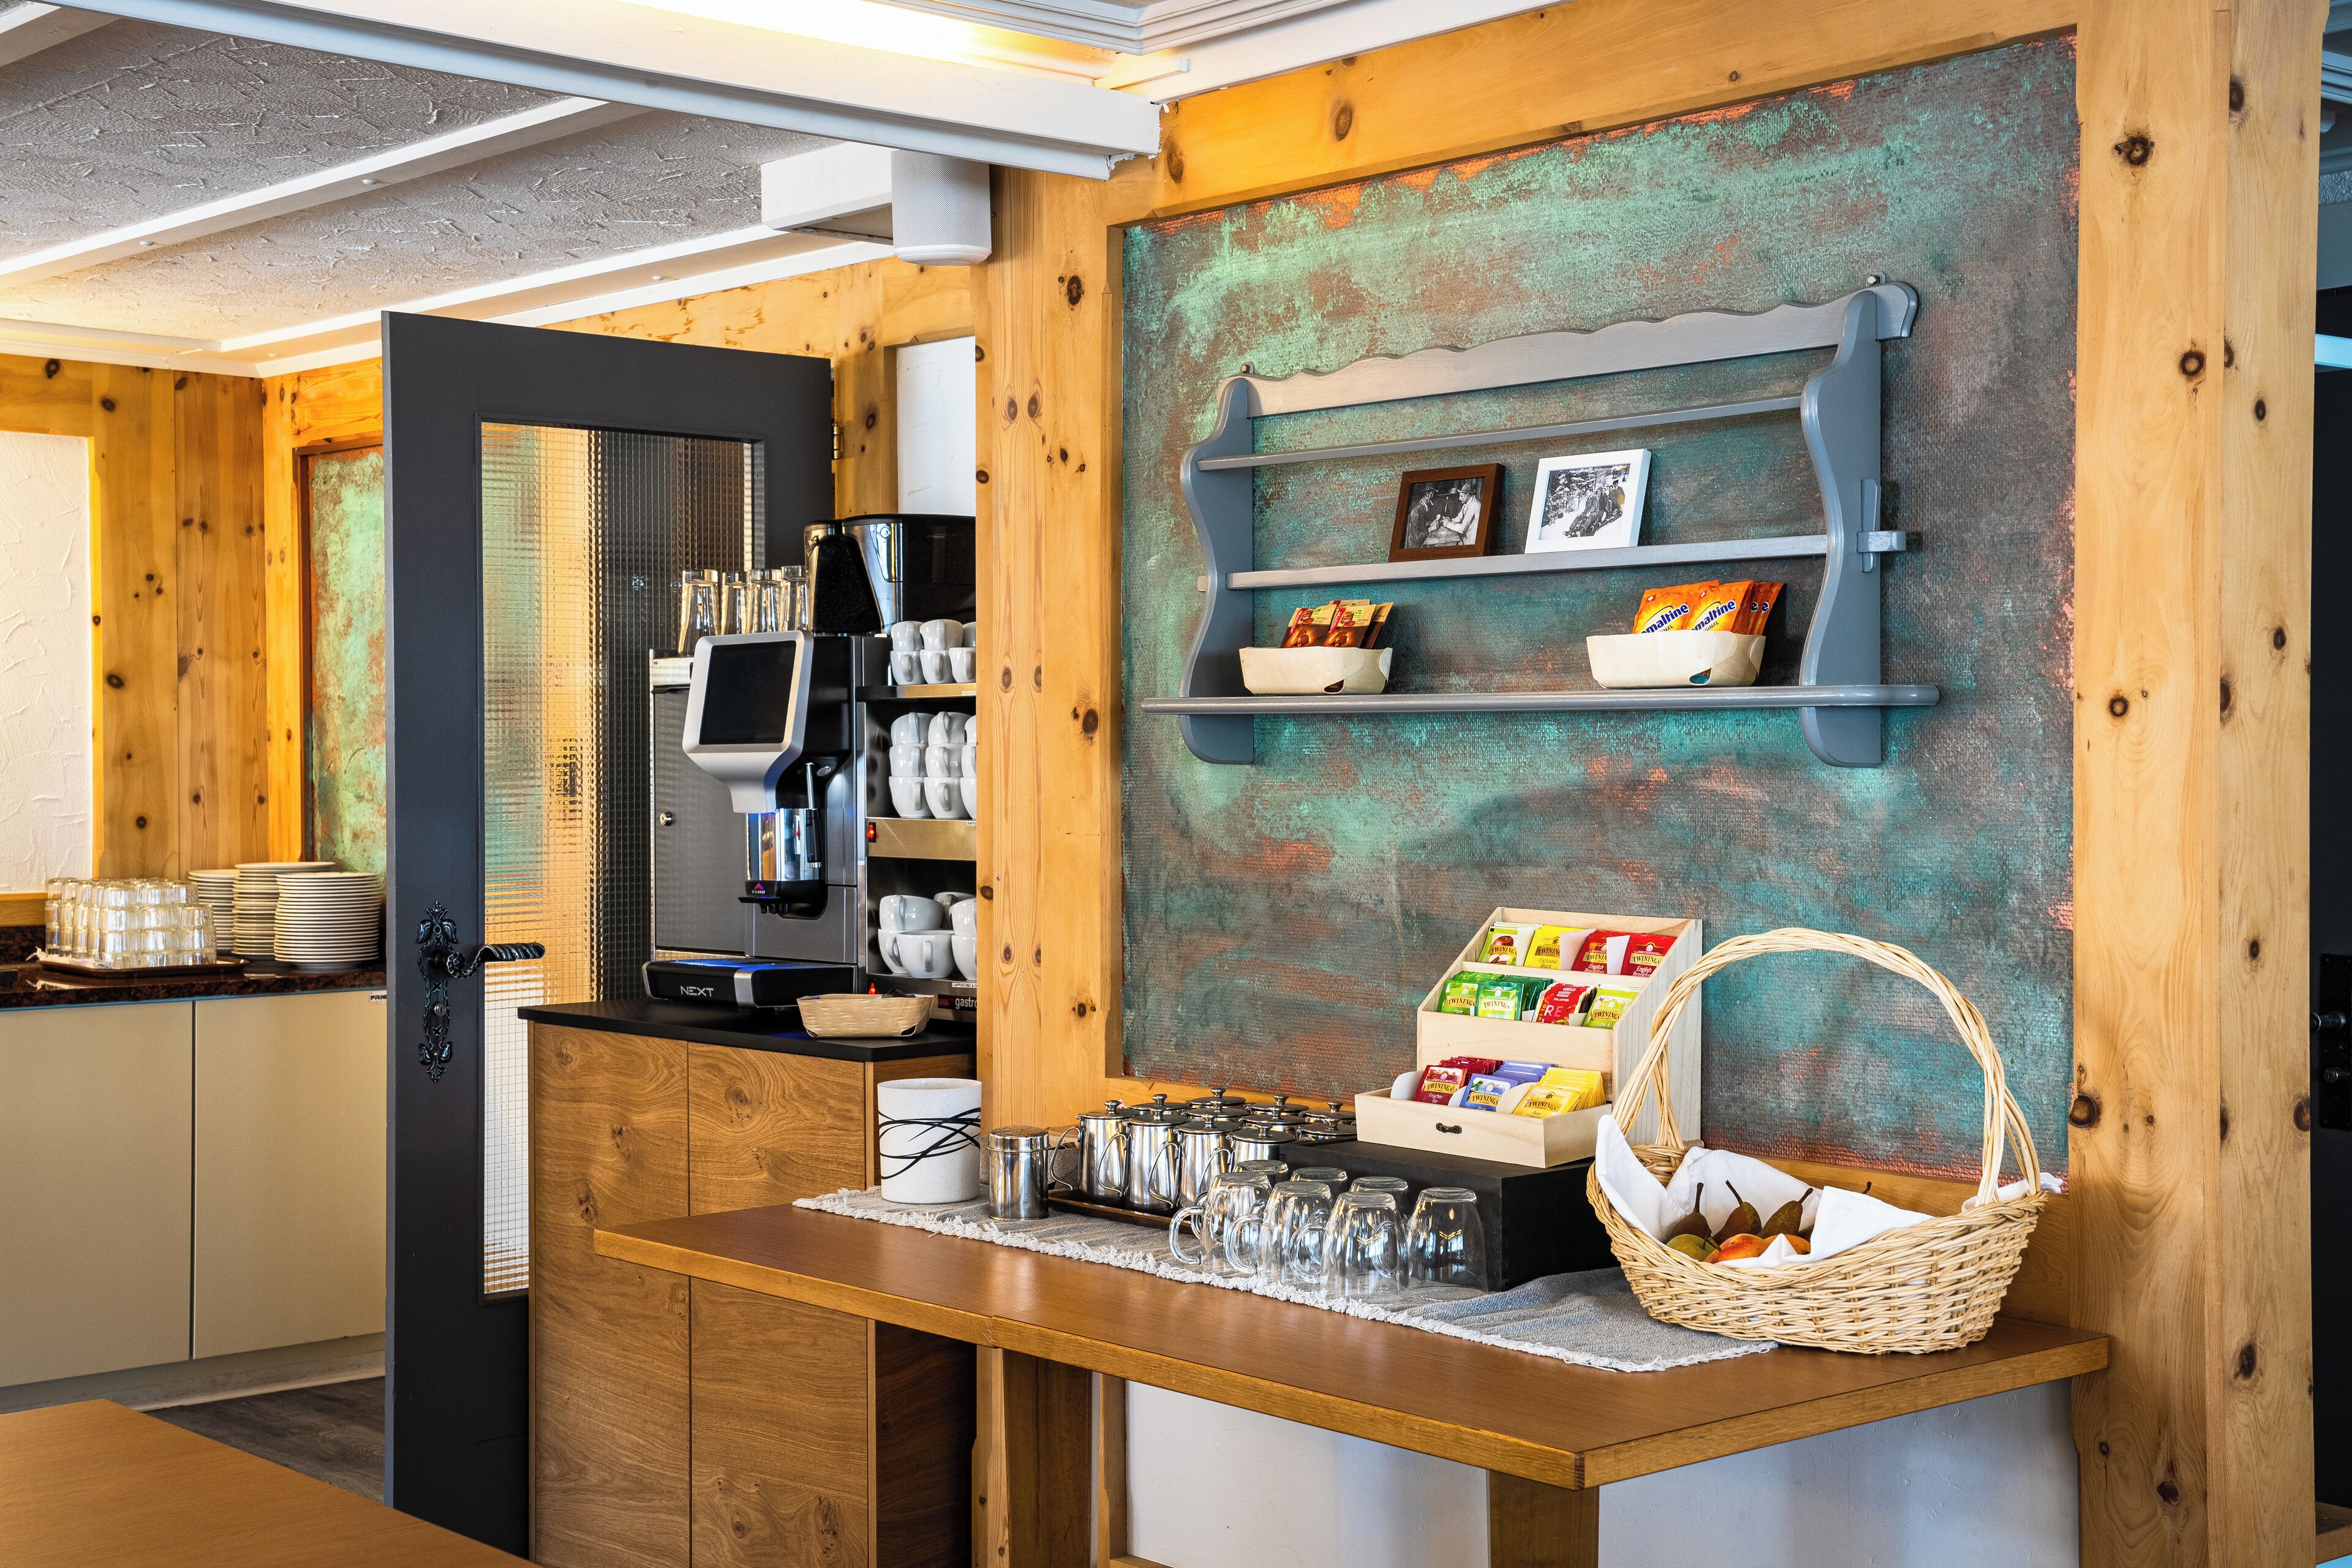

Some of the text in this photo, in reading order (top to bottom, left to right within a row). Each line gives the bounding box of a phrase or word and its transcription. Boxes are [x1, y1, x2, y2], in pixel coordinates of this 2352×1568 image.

[1691, 601, 1736, 630] maltine
[1632, 956, 1661, 965] TWININGS
[680, 986, 714, 997] NEXT
[1448, 998, 1476, 1006] TWININGS
[1483, 1000, 1510, 1009] TWININGS
[1427, 1083, 1454, 1093] TWININGS
[1472, 1095, 1499, 1106] TWININGS
[1529, 1101, 1558, 1110] TWININGS
